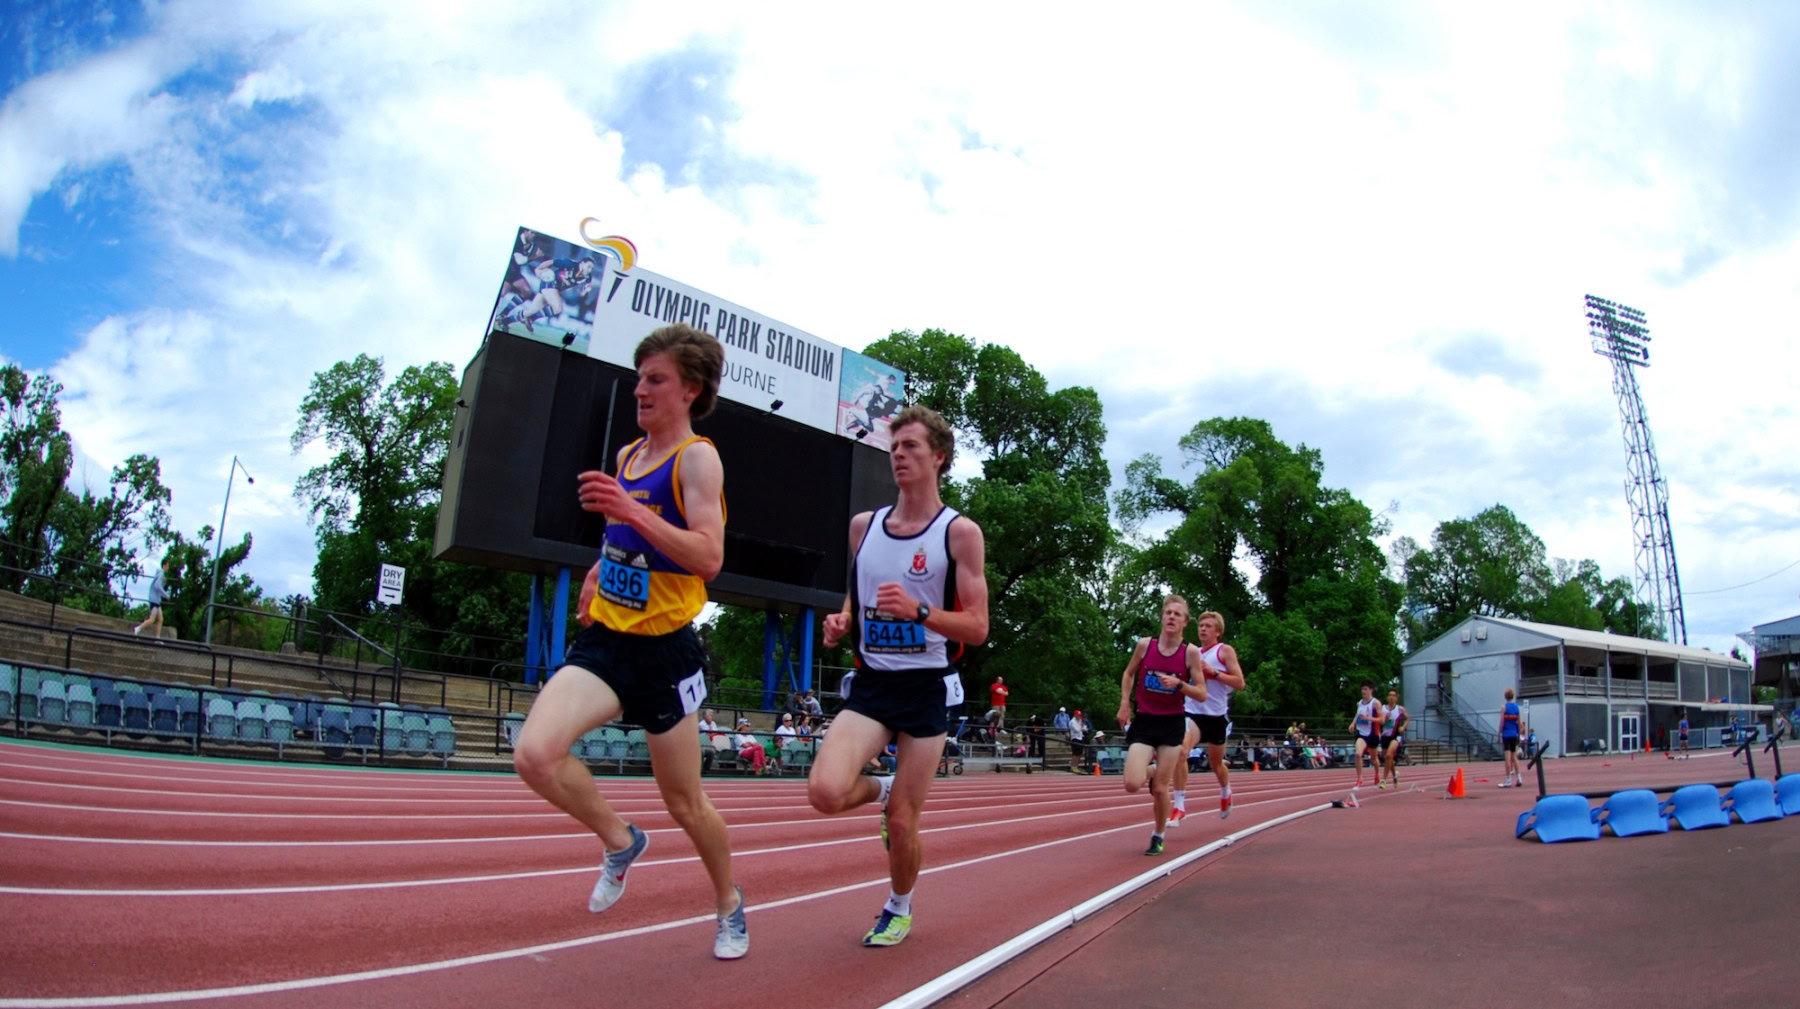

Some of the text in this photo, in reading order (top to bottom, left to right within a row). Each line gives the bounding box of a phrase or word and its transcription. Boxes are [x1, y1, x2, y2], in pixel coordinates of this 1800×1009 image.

[632, 279, 835, 382] OLYMPIC PARK STADIUM
[721, 361, 776, 395] OURNE
[383, 568, 402, 579] DRY
[383, 579, 401, 587] AREA
[868, 623, 917, 645] 6441
[686, 677, 702, 704] 11
